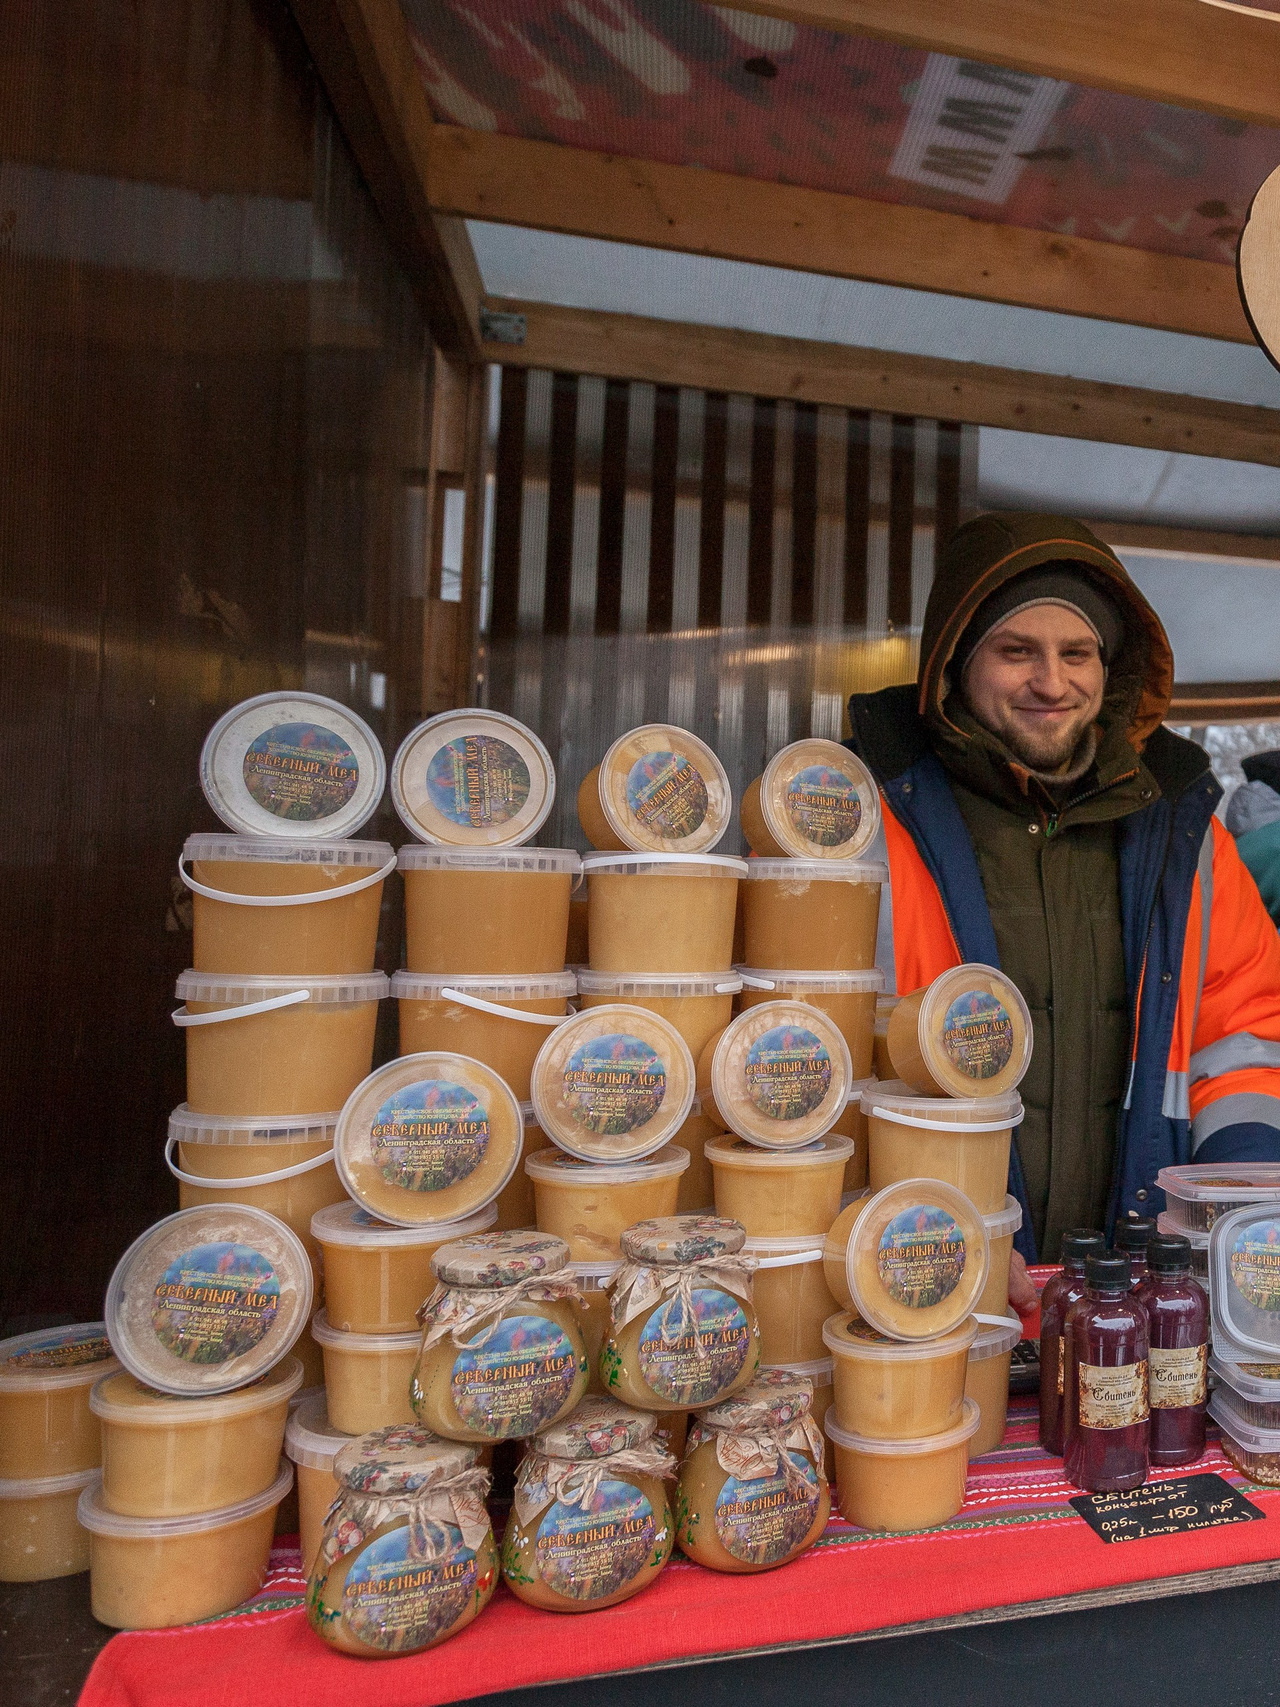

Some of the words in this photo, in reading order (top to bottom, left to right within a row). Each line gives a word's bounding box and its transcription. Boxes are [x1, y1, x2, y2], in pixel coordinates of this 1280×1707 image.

[246, 751, 320, 774] СЕВЕРНЫЙ
[565, 1071, 631, 1085] СЕВЕРНЫЙ
[372, 1121, 449, 1136] СЕВЕРНЫЙ
[379, 1138, 441, 1147] Ленинградская
[156, 1284, 237, 1304] СЕВЕРНЫЙ
[160, 1300, 226, 1314] Ленинградская
[228, 1308, 261, 1318] область
[454, 1361, 536, 1385] СЕВЕРНЫЙ
[1156, 1368, 1198, 1382] Сбитень
[462, 1381, 528, 1395] Ленинградская
[531, 1375, 562, 1386] область
[1092, 1387, 1136, 1401] Сбитень
[717, 1491, 786, 1517] СЕВЕРНЫЙ
[538, 1523, 614, 1549] СЕВЕРНЫЙ
[545, 1543, 608, 1560] Ленинградская
[611, 1536, 642, 1548] область
[346, 1570, 432, 1597] СЕВЕРНЫЙ
